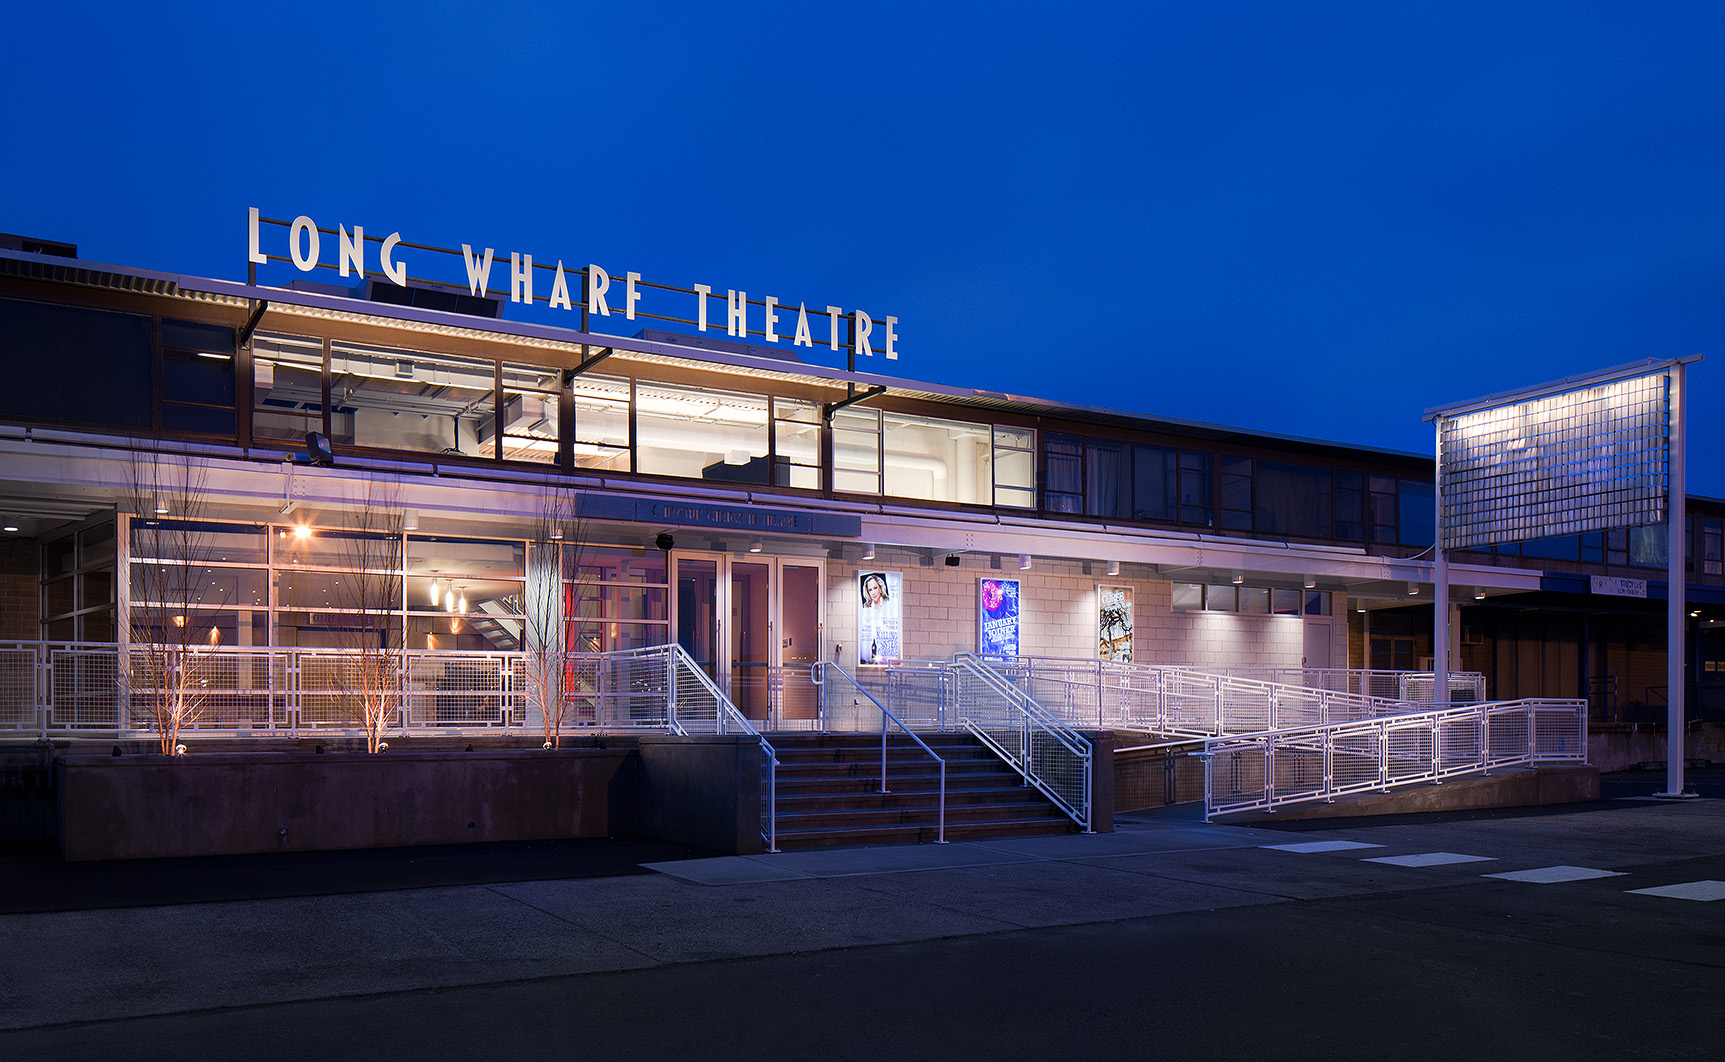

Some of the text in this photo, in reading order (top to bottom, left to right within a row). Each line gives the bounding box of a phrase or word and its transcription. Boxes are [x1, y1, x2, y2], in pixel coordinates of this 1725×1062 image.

[248, 206, 899, 361] LONG WHARF THEATRE
[664, 505, 701, 521] NEWTON
[762, 513, 798, 528] THEATRE
[983, 616, 1017, 632] JANUARY
[988, 625, 1016, 640] JOINER
